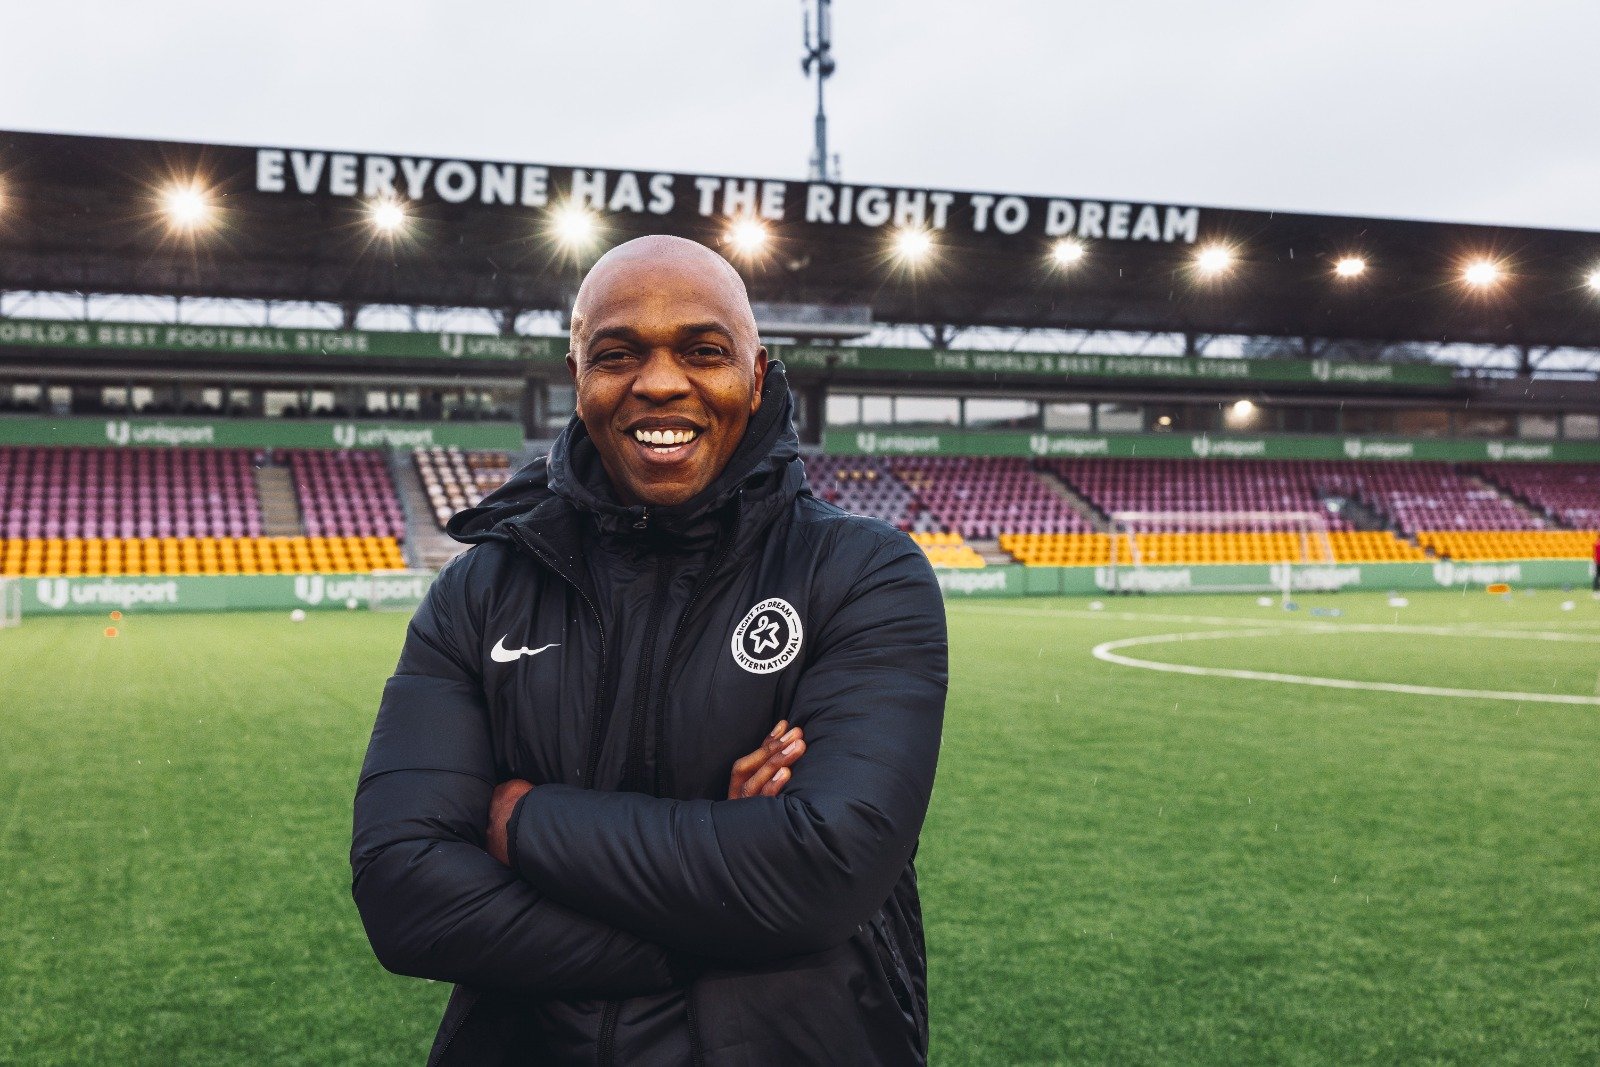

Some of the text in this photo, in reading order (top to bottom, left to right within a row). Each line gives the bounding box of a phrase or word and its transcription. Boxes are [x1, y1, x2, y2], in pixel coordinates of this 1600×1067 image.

[255, 150, 1199, 244] EVERYONE HAS THE RIGHT TO DREAM
[99, 325, 156, 346] BEST
[165, 327, 287, 350] FOOTBALL
[296, 331, 369, 352] STORE
[71, 578, 178, 608] unisport
[326, 575, 423, 603] unisport
[736, 601, 793, 636] RIGHT TO DREAM
[736, 636, 800, 671] INTERNATIONAL
